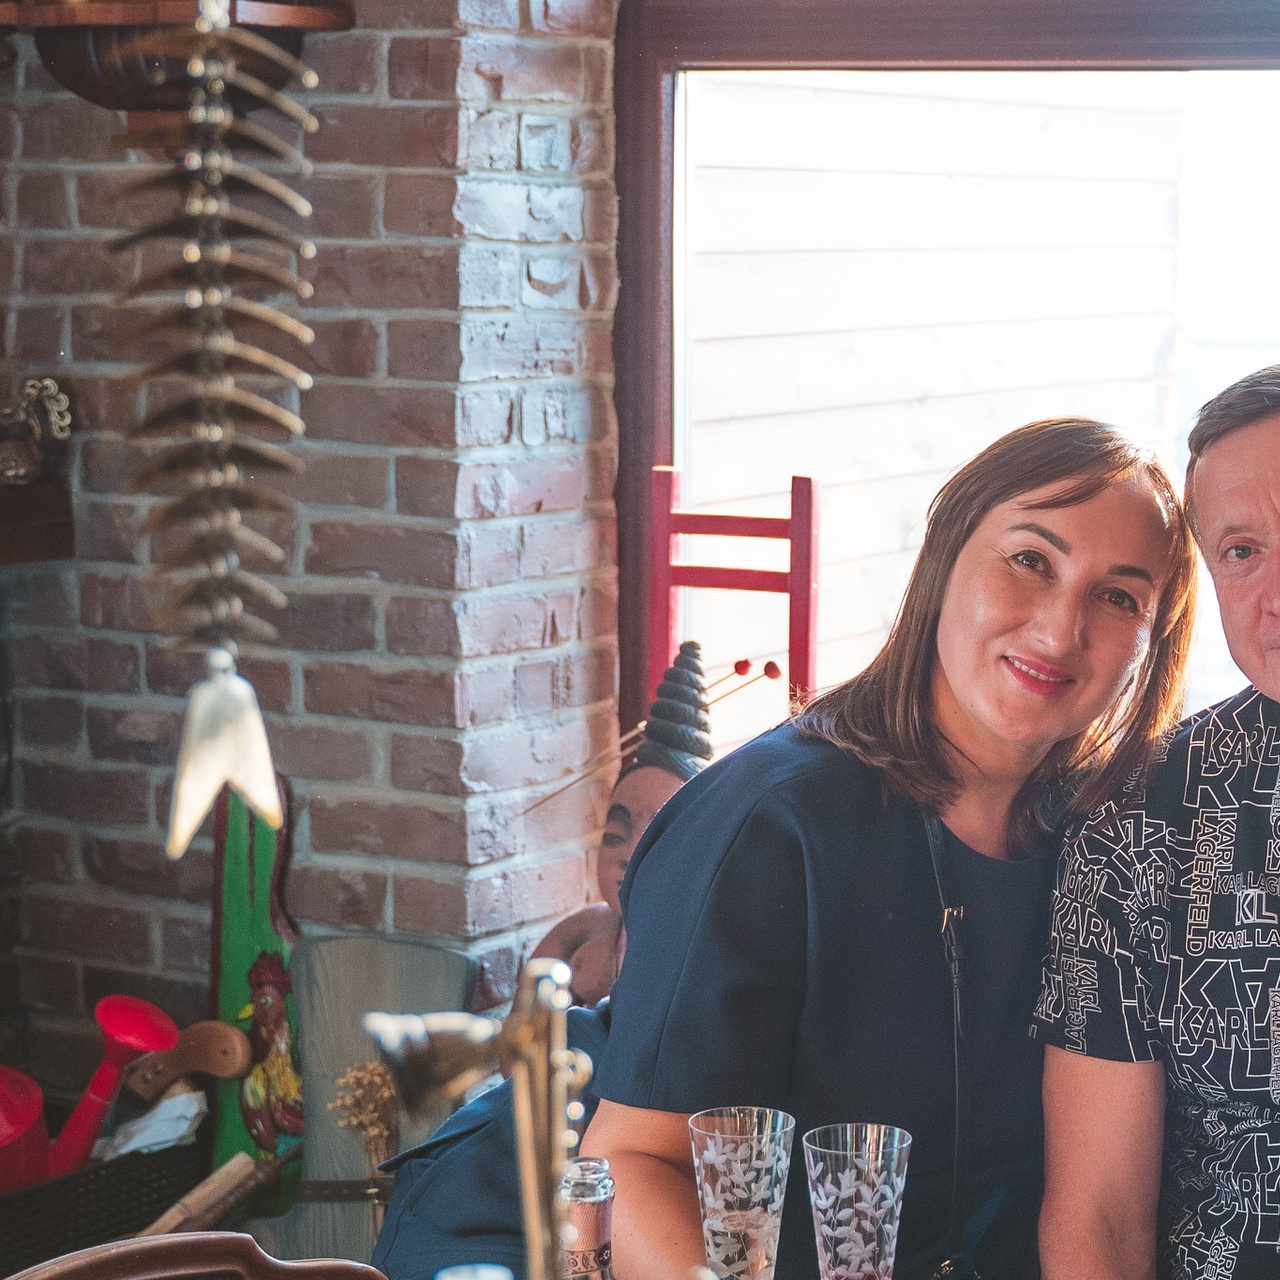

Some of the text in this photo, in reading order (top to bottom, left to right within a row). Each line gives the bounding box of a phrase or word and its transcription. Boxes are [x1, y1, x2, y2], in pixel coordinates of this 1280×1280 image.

[1216, 809, 1237, 871] KARL
[1186, 809, 1220, 956] LAGERFELD
[1214, 872, 1247, 895] KARL
[1235, 888, 1279, 926] KL
[1208, 929, 1253, 950] KARL
[1173, 1005, 1271, 1049] KARL
